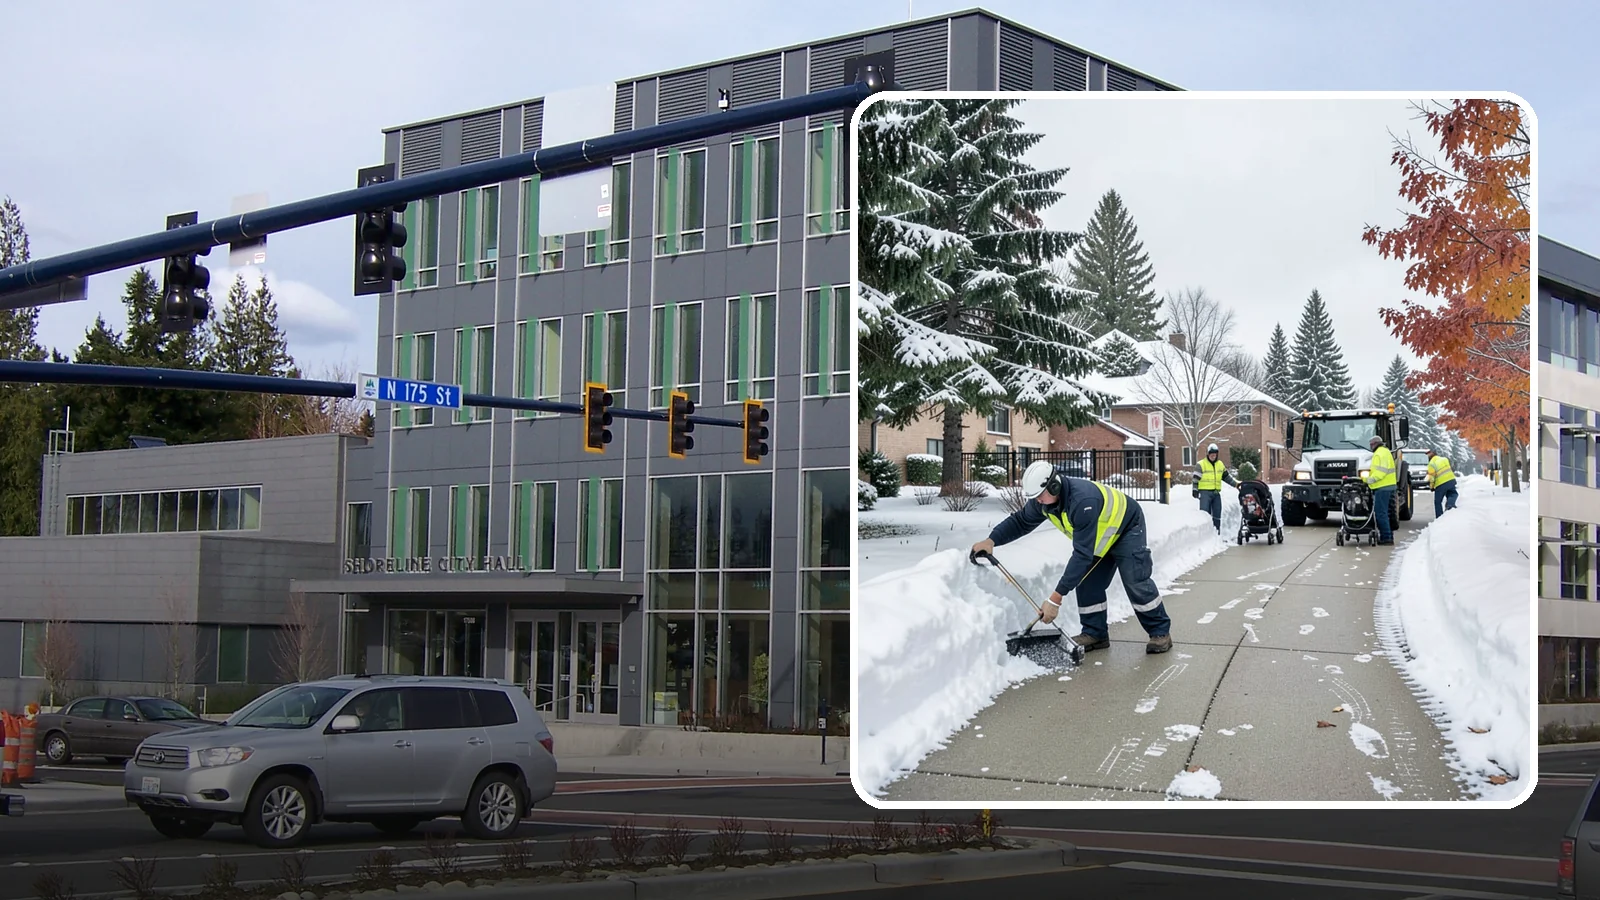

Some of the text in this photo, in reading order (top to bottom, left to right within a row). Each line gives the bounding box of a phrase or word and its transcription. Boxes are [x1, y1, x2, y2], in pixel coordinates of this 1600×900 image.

[387, 380, 451, 406] N 175 St
[343, 556, 525, 574] SHORELINE CITY HALL
